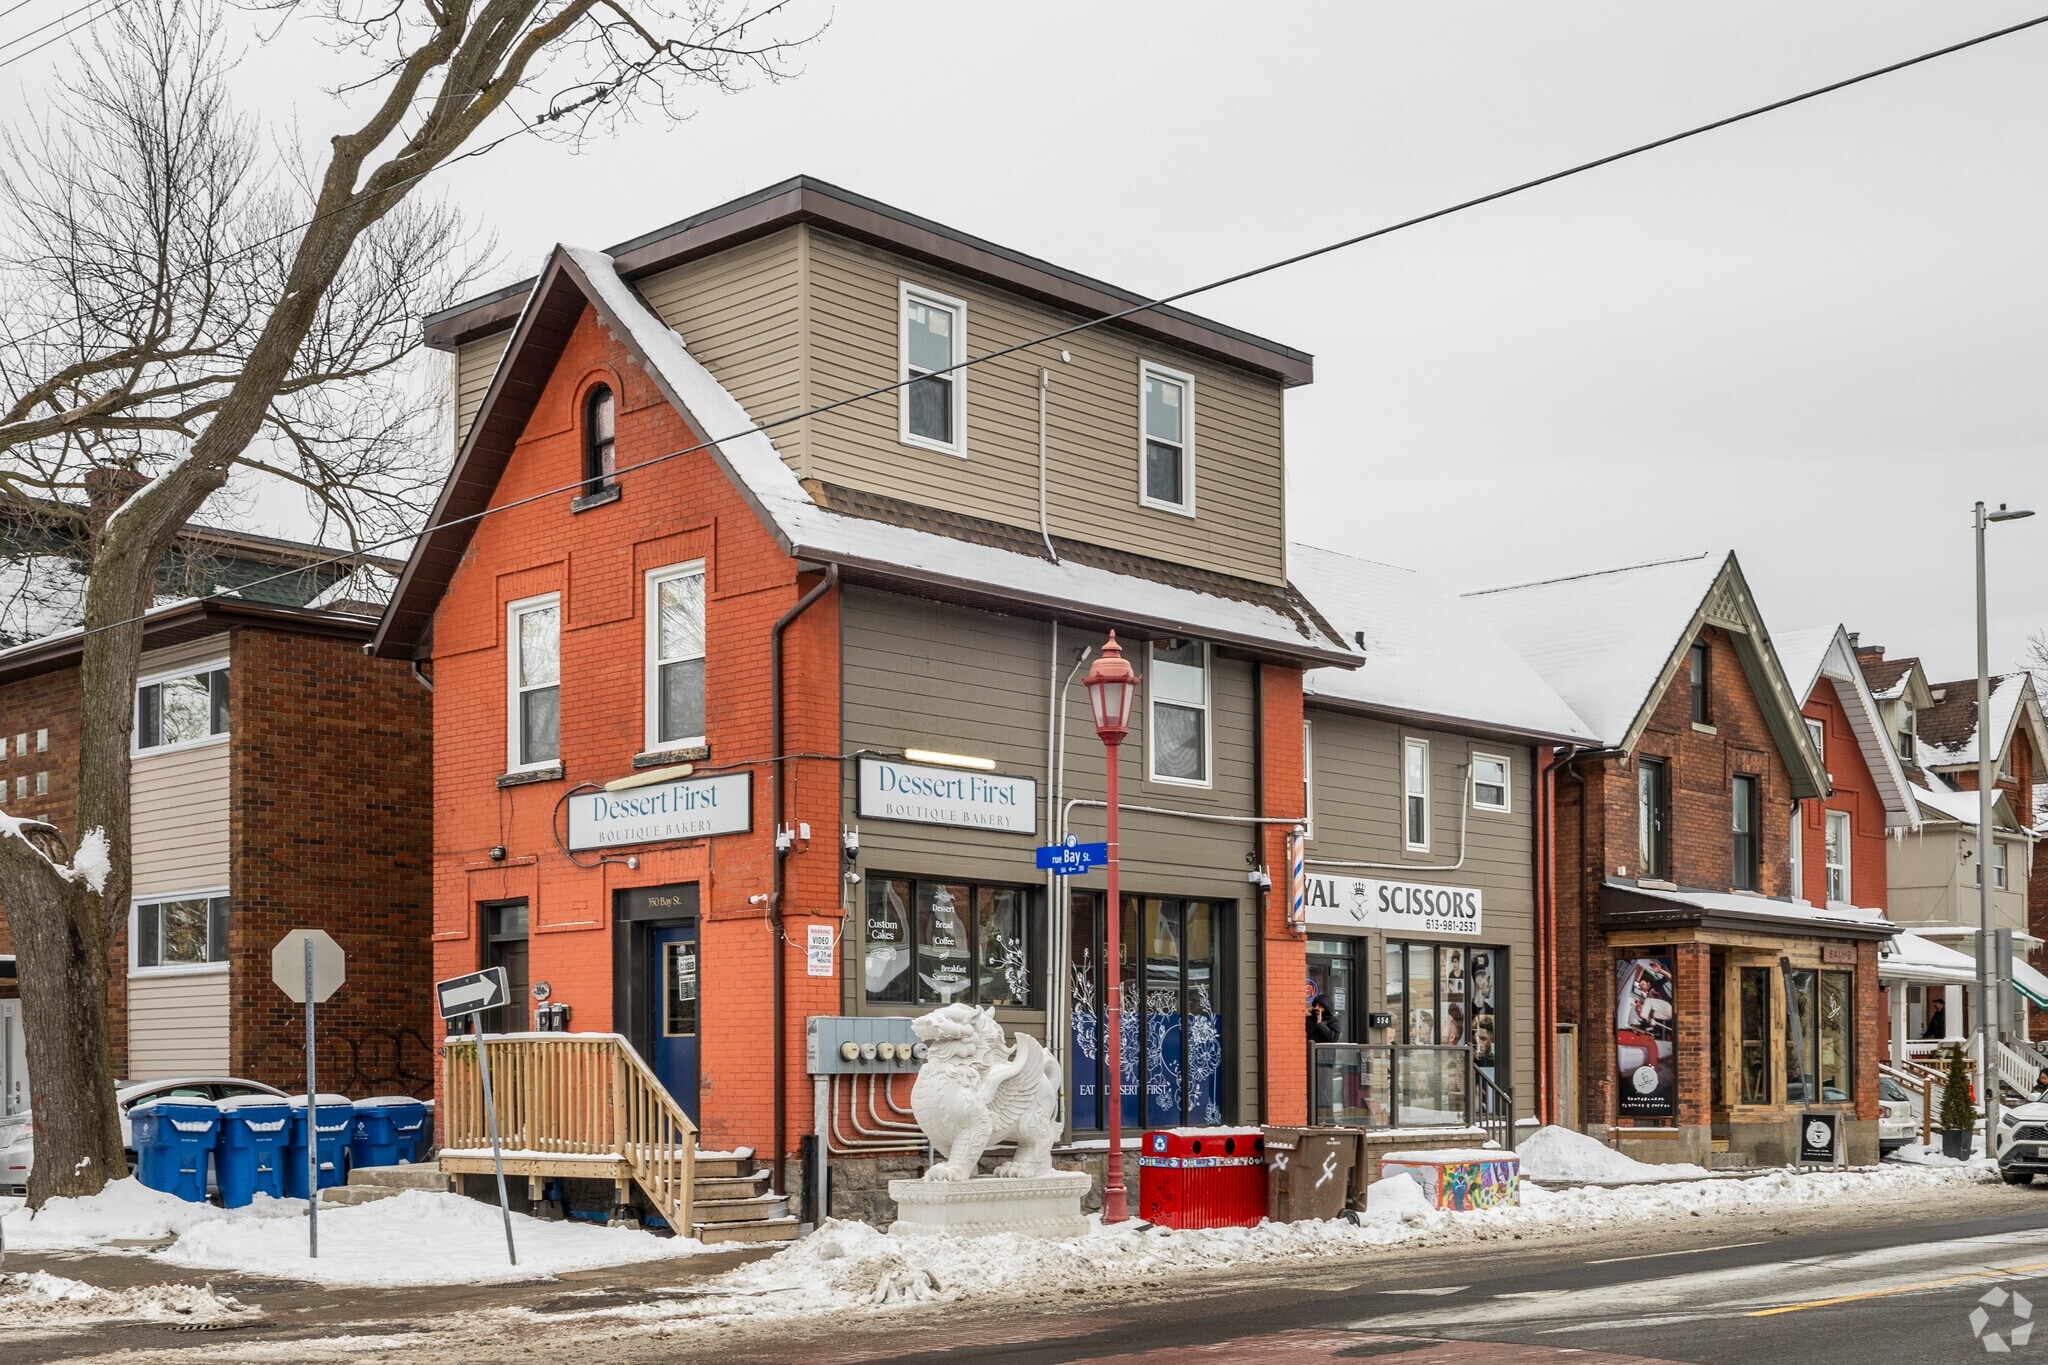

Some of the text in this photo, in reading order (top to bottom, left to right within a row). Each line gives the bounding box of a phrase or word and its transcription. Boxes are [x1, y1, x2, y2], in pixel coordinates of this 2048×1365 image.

[879, 765, 1016, 806] Dessert First
[593, 784, 719, 822] Dessert First
[886, 803, 1012, 827] BOUTIQUE BAKERY
[599, 819, 713, 843] BOUTIQUE BAKERY
[1051, 849, 1091, 866] rue Bay St.
[647, 897, 660, 908] 350
[660, 896, 673, 908] Bay
[1303, 878, 1476, 919] YAL SCISSORS
[932, 904, 955, 913] Dessert
[868, 919, 898, 929] Custom
[935, 921, 953, 929] Bread
[1426, 918, 1477, 932] 613-981-2531
[812, 936, 829, 945] VIDEO
[871, 930, 894, 940] Cakes
[934, 937, 955, 946] Coffee
[941, 965, 966, 973] Breakfast
[1079, 1084, 1167, 1096] EAT DSERT FIRST
